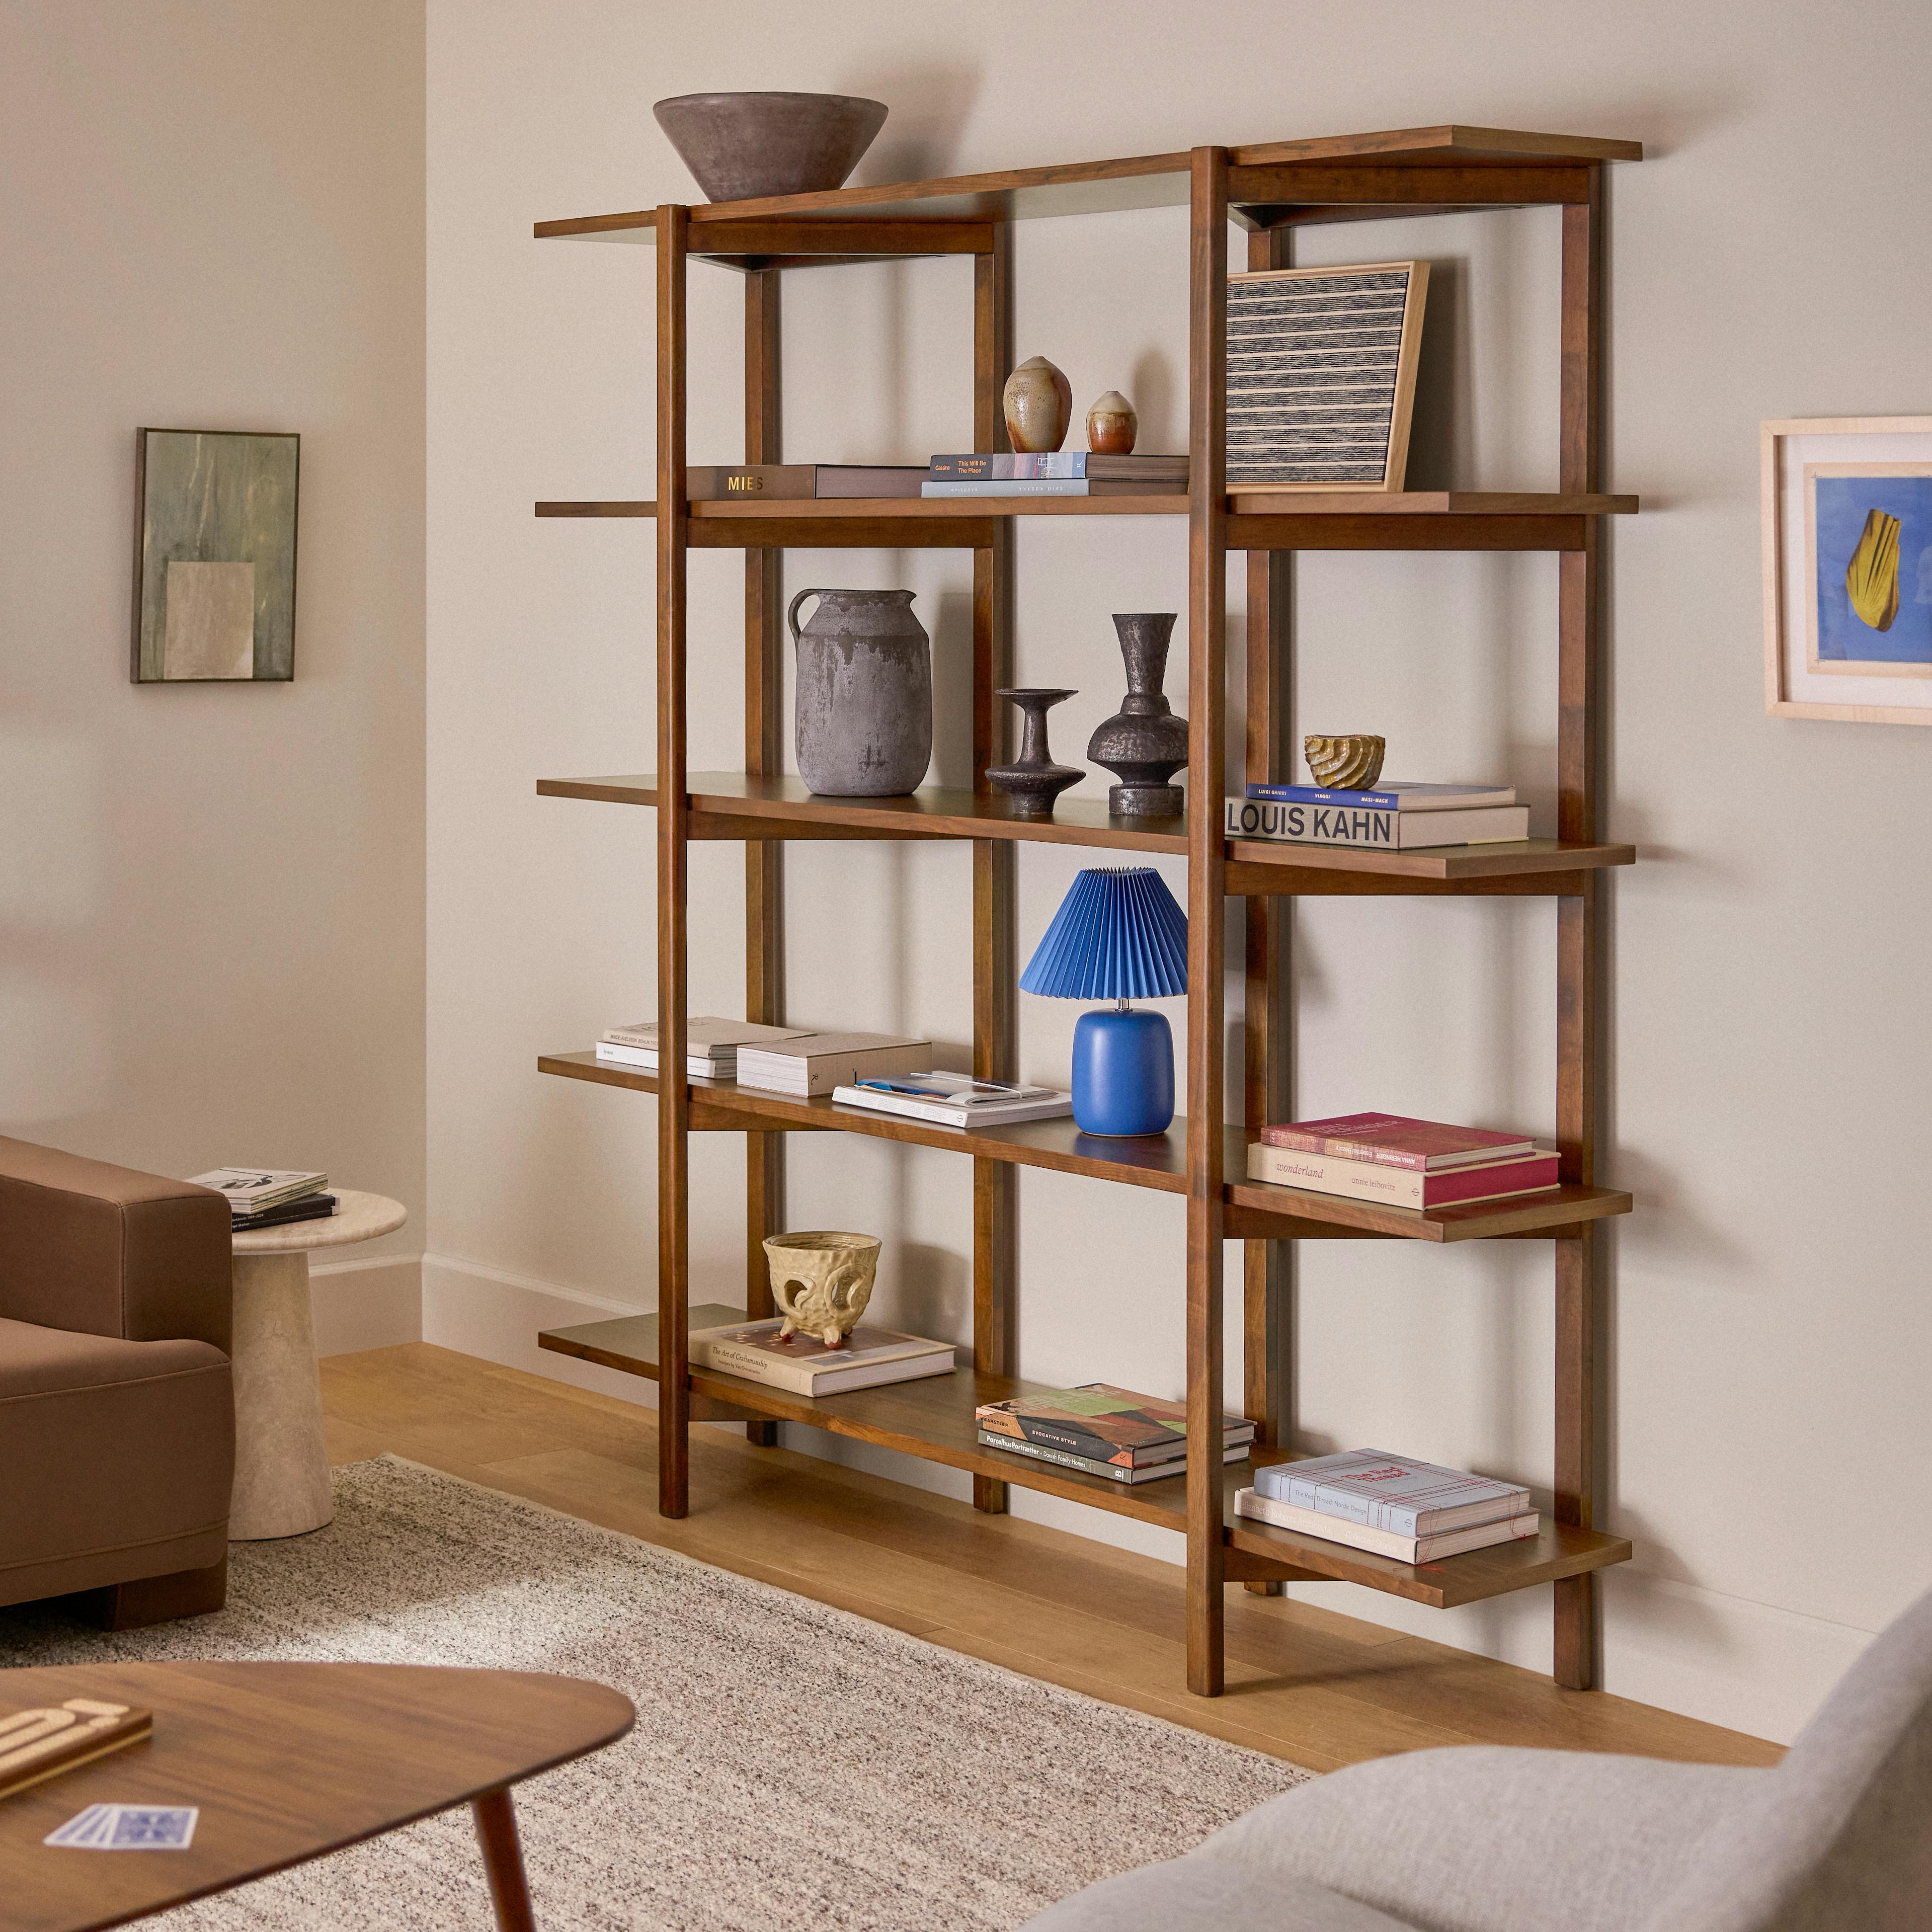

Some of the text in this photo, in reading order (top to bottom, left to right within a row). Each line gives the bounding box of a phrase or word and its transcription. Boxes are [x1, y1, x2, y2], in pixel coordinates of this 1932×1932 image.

[728, 476, 763, 491] MIES
[1228, 803, 1391, 842] LOUIS KAHN
[1335, 1145, 1351, 1154] Beauty
[1352, 1149, 1373, 1157] Essential
[1376, 1153, 1401, 1162] HERINGER
[1276, 1163, 1324, 1179] wonderland
[1351, 1177, 1396, 1191] annie leibovitz
[712, 1346, 720, 1354] The
[736, 1353, 768, 1370] Craftsmanship
[981, 1417, 1008, 1427] WEARSTLER
[1032, 1430, 1077, 1445] EVOCATIVE STYLE
[987, 1435, 1086, 1468] ParcelhusPortrætter Danish Family Homes
[1357, 1471, 1411, 1482] Thread
[1368, 1466, 1403, 1475] Red
[1305, 1492, 1313, 1500] Red
[1316, 1496, 1333, 1505] Thread:
[1334, 1501, 1350, 1510] Nordic
[1351, 1505, 1366, 1515] Design
[1241, 1501, 1332, 1534] Elizabeth Roberts Architects
[1345, 1531, 1375, 1546] Collected
[1375, 1539, 1398, 1552] Stories
